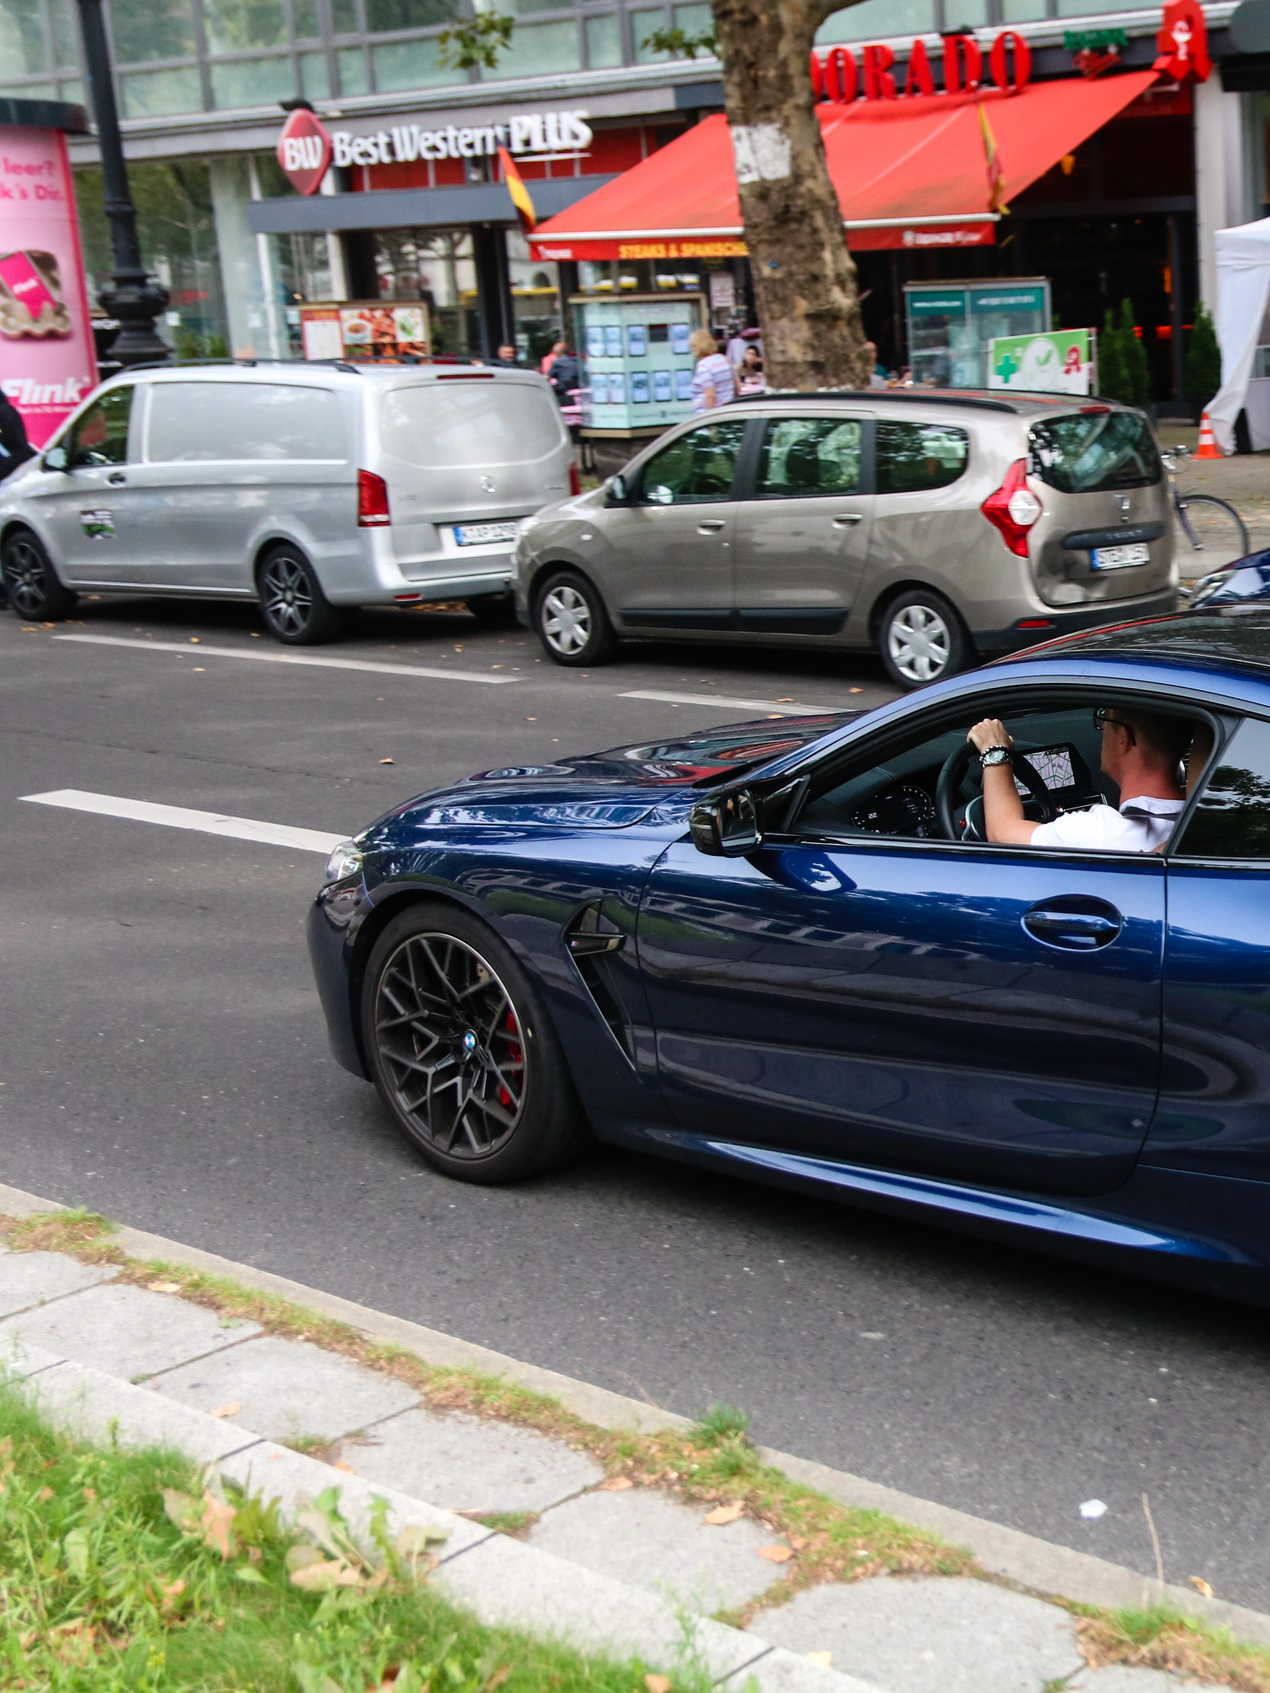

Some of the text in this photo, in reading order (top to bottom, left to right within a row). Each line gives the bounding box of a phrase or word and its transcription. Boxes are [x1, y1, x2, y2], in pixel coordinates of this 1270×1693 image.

[283, 136, 322, 172] BW
[332, 109, 593, 168] Best Western PLUS
